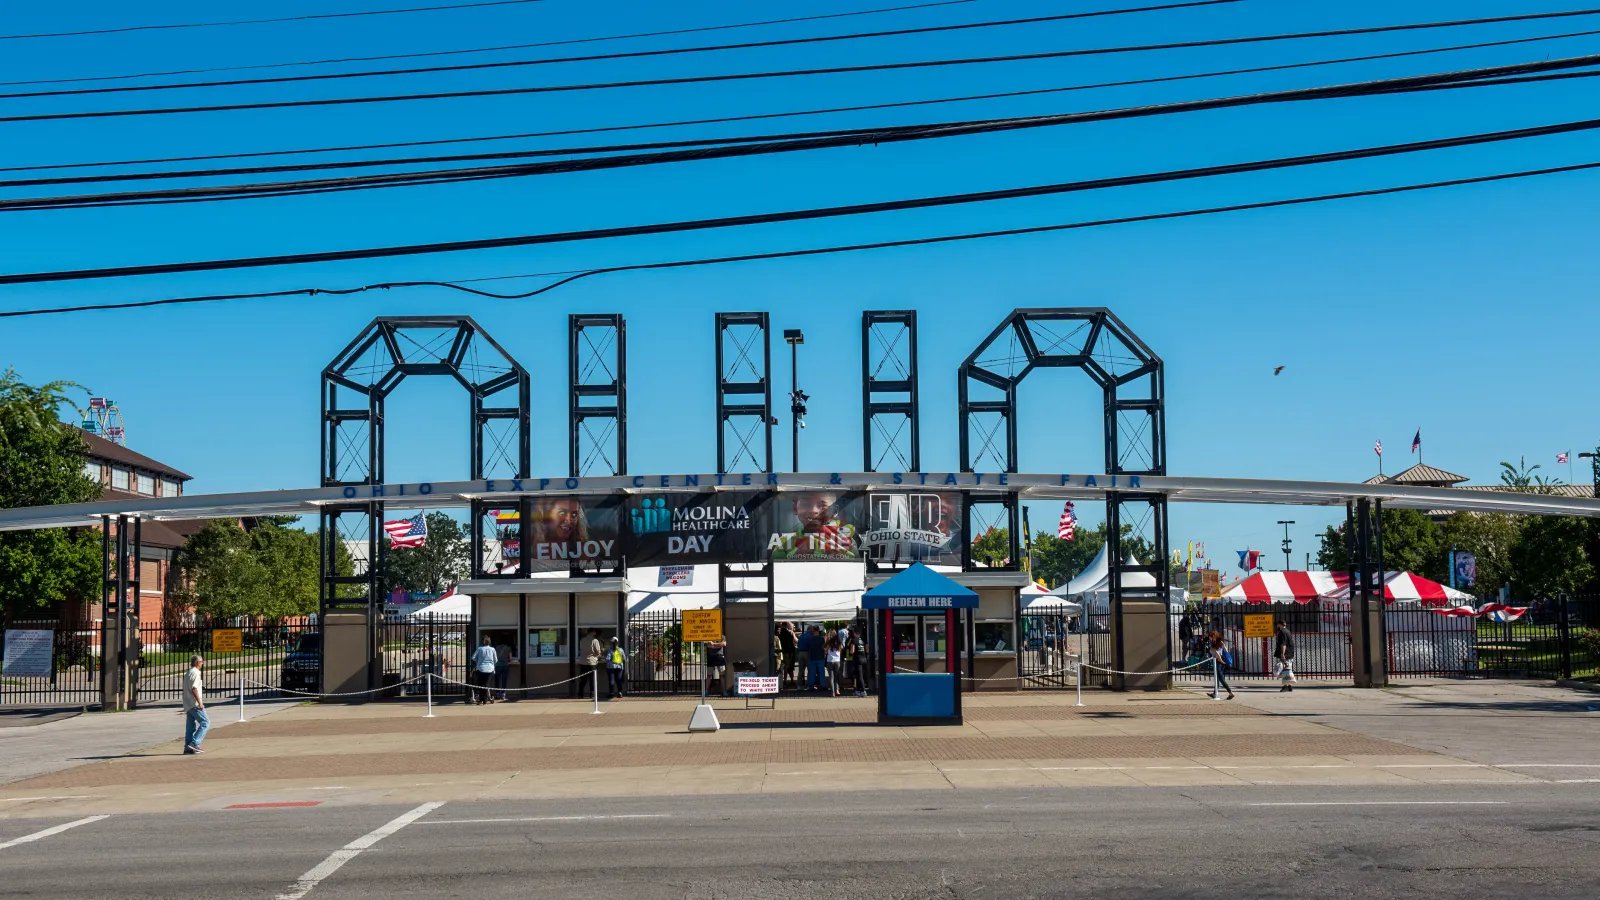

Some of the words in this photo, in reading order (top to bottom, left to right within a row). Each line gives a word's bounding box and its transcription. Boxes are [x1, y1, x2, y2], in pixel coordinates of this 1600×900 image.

[343, 482, 432, 498] OHIO
[486, 477, 579, 492] EXPO
[632, 473, 779, 488] CENTER
[829, 473, 842, 485] &
[892, 472, 1008, 486] STATE
[1061, 473, 1141, 488] FAIR
[672, 505, 750, 521] MOLINA
[672, 519, 750, 531] HEALTHCARE
[668, 534, 714, 554] DAY
[767, 532, 796, 550] AT
[803, 532, 852, 550] THE
[870, 530, 901, 542] OHIO
[903, 531, 941, 545] STATE
[536, 540, 615, 560] ENJOY
[888, 596, 927, 607] REDEEM
[928, 597, 953, 607] HERE
